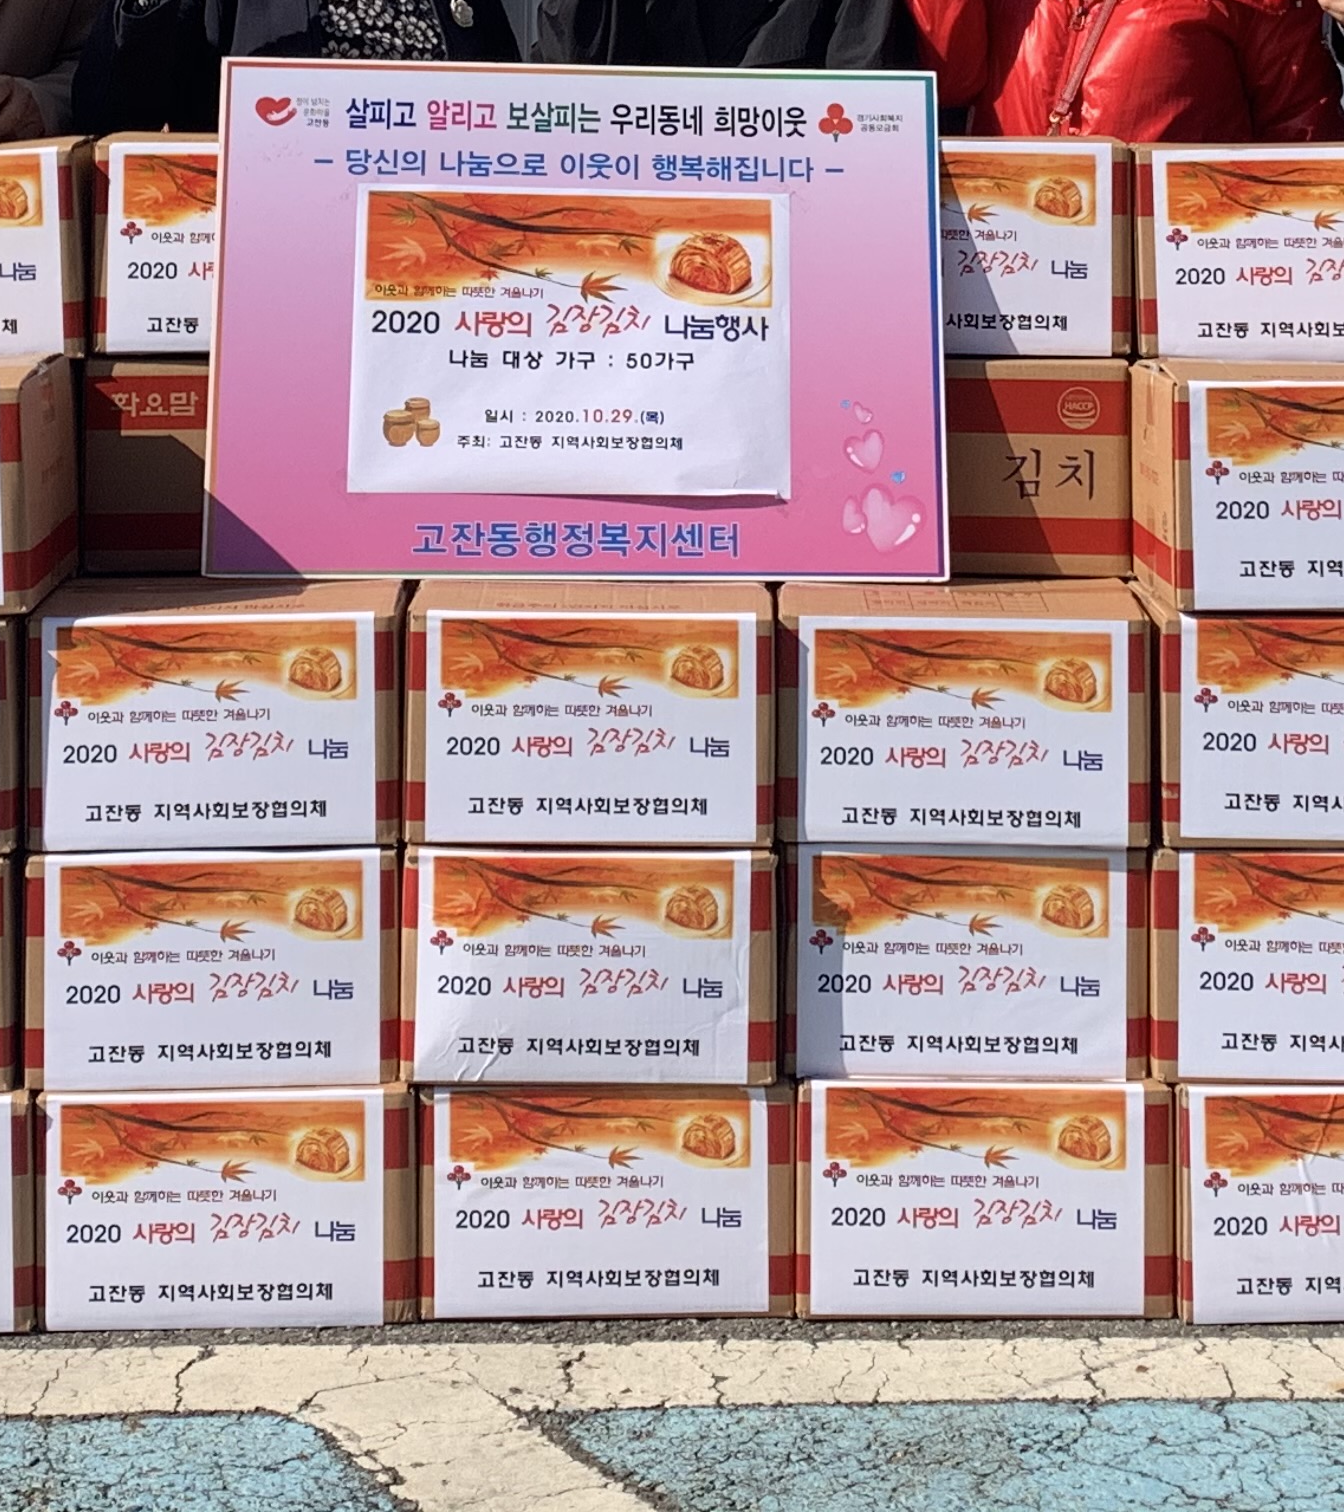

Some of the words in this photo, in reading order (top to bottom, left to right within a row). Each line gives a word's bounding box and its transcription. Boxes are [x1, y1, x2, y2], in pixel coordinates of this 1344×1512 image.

[346, 98, 417, 130] 살피고
[427, 99, 497, 131] 알리고
[506, 101, 601, 134] 보살피는
[610, 104, 703, 136] 우리동네
[714, 106, 807, 137] 희망이웃
[346, 149, 426, 176] 당신의
[440, 150, 548, 177] 나눔으로
[560, 153, 639, 180] 이웃이
[652, 154, 814, 182] 행복해집니다
[151, 232, 185, 244] 이웃과
[190, 232, 215, 244] 함께
[975, 229, 1017, 242] 겨울나기
[1197, 238, 1230, 249] 이웃과
[1236, 238, 1278, 249] 함께하는
[1284, 237, 1317, 248] 따뜻한
[0, 262, 36, 281] 나눔
[128, 262, 177, 279] 2020
[958, 250, 1039, 278] 김장김치
[1051, 260, 1088, 280] 나눔
[1176, 268, 1225, 285] 2020
[1236, 266, 1292, 286] 사랑의
[374, 284, 408, 297] 이웃과
[413, 284, 456, 297] 함께하는
[462, 286, 495, 299] 따뜻한
[500, 287, 544, 299] 겨울나기
[147, 317, 199, 334] 고잔동
[372, 310, 440, 334] 2020
[454, 311, 532, 338] 사랑의
[546, 304, 651, 338] 김장김치
[665, 314, 769, 341] 나눔행사
[946, 313, 1067, 331] 사회보장협의체
[1198, 323, 1249, 338] 고잔동
[449, 350, 488, 368] 나눔
[503, 351, 543, 370] 대상
[556, 352, 595, 370] 가구
[626, 352, 694, 371] 50가구
[484, 409, 514, 423] 일시
[457, 435, 491, 449] 주최:
[499, 435, 542, 449] 고잔동
[552, 435, 683, 450] 지역사회보장협의체
[1002, 448, 1094, 501] 김치
[411, 521, 740, 558] 고잔동행정복지센터
[472, 704, 507, 716] 이웃과
[513, 704, 559, 717] 함께하는
[565, 704, 600, 717] 따뜻한
[606, 704, 652, 717] 겨울나기
[447, 737, 500, 755] 2020
[512, 736, 572, 758] 사랑의
[587, 728, 676, 756] 김장김치
[690, 737, 730, 757] 나눔
[468, 798, 523, 815] 고잔동
[537, 797, 707, 816] 지역사회보장협의체
[91, 951, 128, 964] 이웃과
[134, 951, 180, 964] 함께하는
[187, 950, 223, 962] 따뜻한
[228, 948, 275, 961] 겨울나기
[1225, 939, 1261, 952] 이웃과
[1267, 940, 1312, 954] 함께하는
[66, 985, 120, 1004] 2020
[132, 982, 194, 1005] 사랑의
[210, 971, 299, 1002] 김장김치
[314, 979, 354, 1000] 나눔
[1200, 971, 1253, 991] 2020
[1265, 973, 1326, 994] 사랑의
[89, 1045, 144, 1063] 고잔동
[158, 1040, 331, 1062] 지역사회보장협의체
[1222, 1033, 1277, 1052] 고잔동
[856, 1174, 893, 1187] 이웃과
[899, 1174, 945, 1187] 함께하는
[951, 1175, 987, 1188] 따뜻한
[992, 1175, 1039, 1188] 겨울나기
[832, 1207, 885, 1227] 2020
[897, 1207, 958, 1229] 사랑의
[974, 1198, 1062, 1229] 김장김치
[1077, 1209, 1117, 1230] 나눔
[853, 1269, 909, 1287] 고잔동
[922, 1270, 1094, 1288] 지역사회보장협의체
